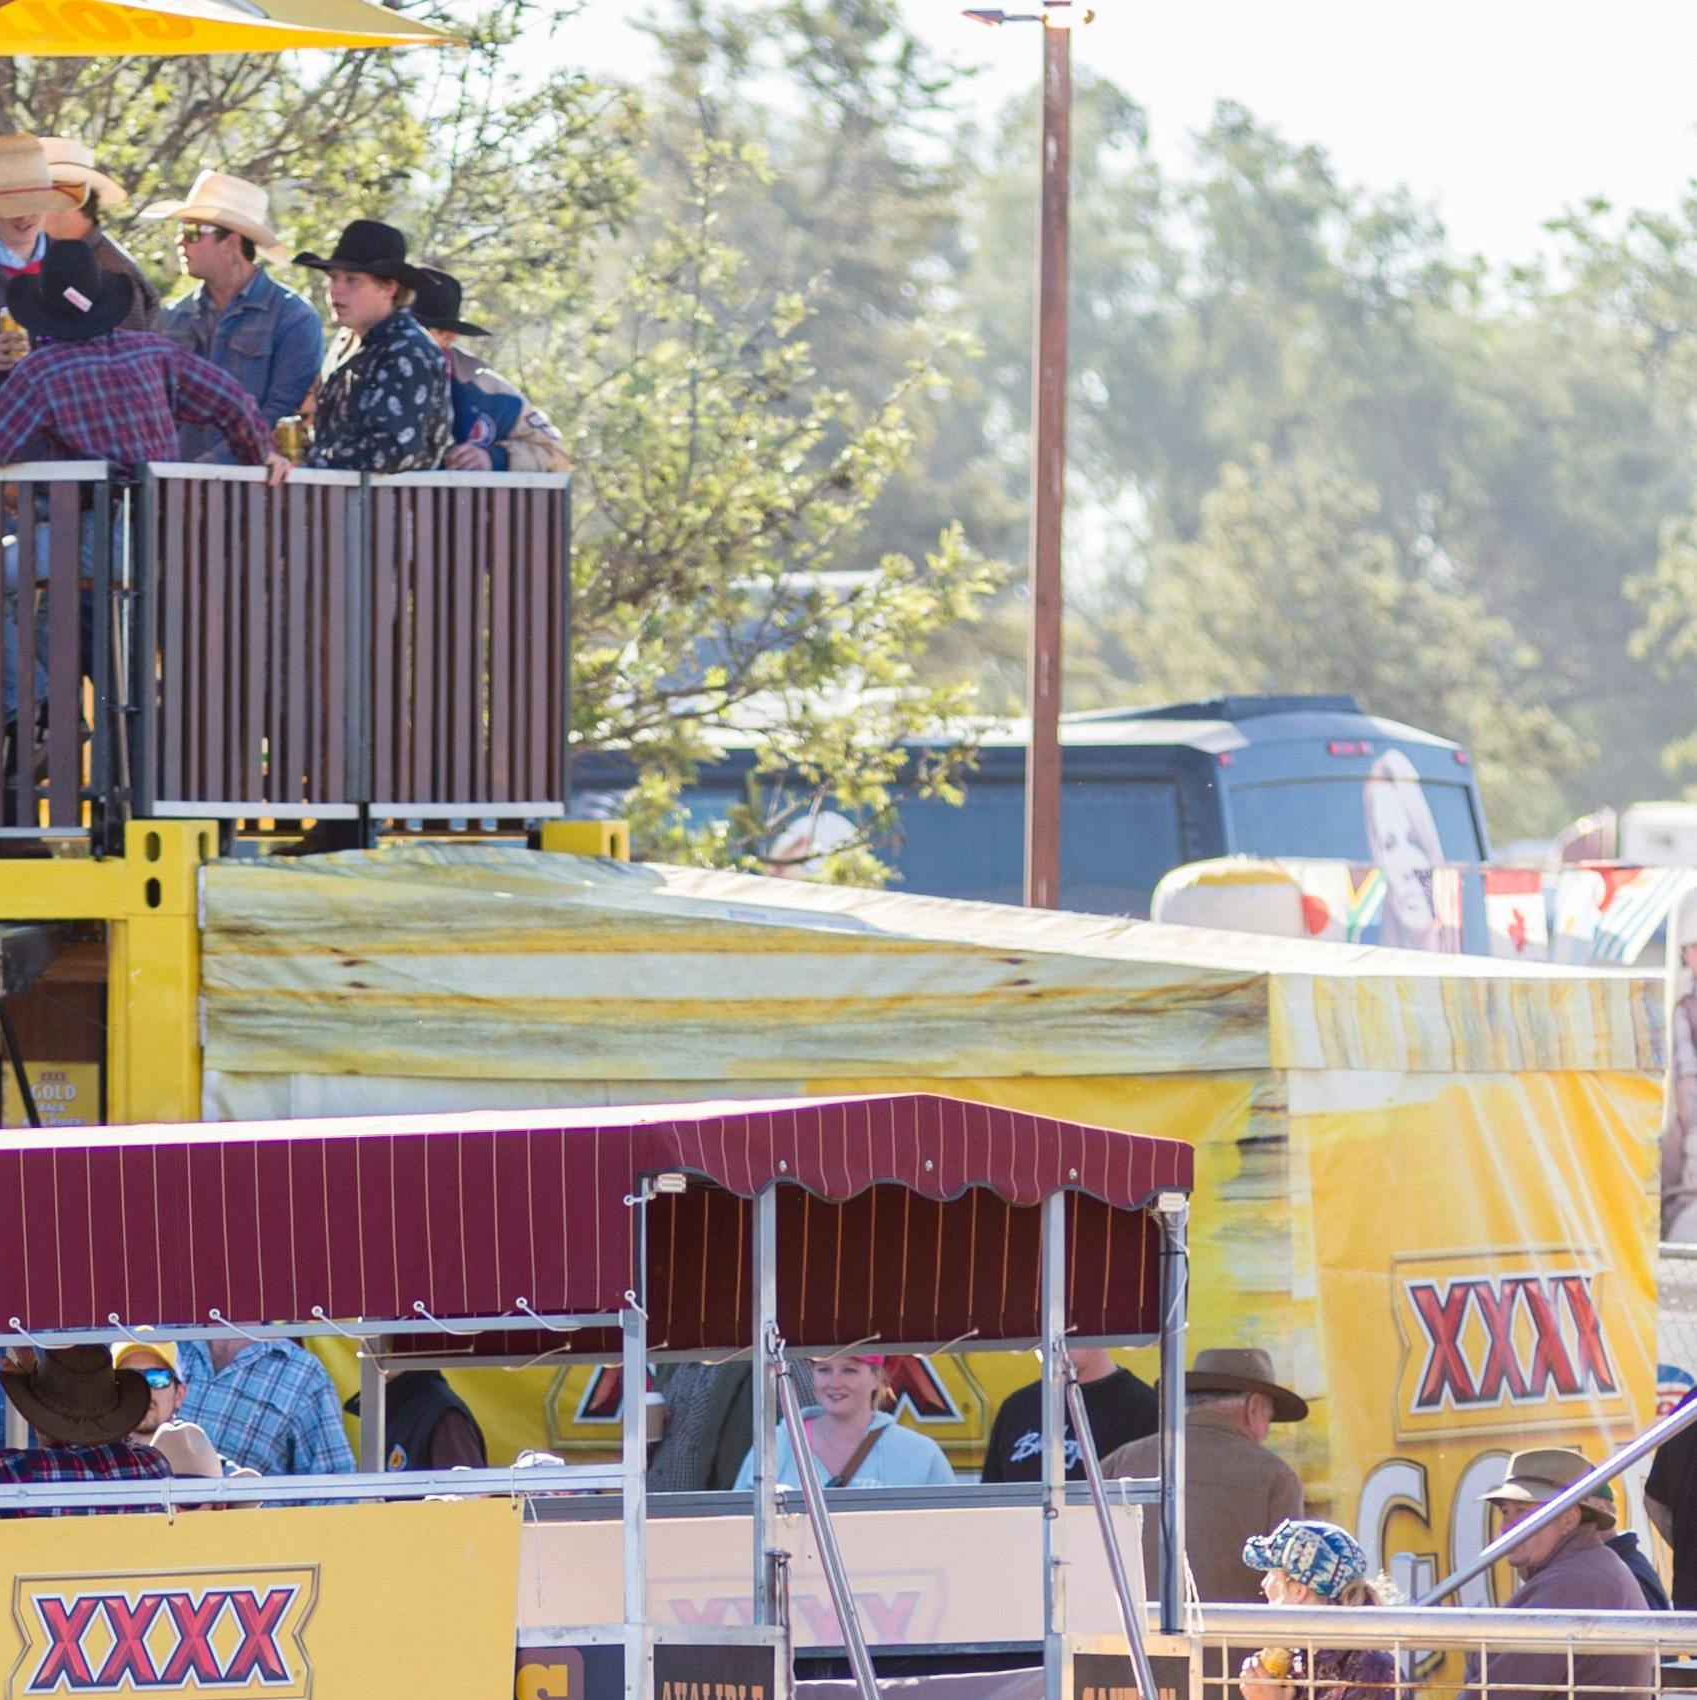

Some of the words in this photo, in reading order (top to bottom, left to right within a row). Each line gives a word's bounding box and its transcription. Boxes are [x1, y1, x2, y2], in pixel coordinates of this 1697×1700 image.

[29, 1083, 77, 1101] GOLD
[1403, 1271, 1621, 1413] XXXX
[26, 1584, 304, 1694] XXXX
